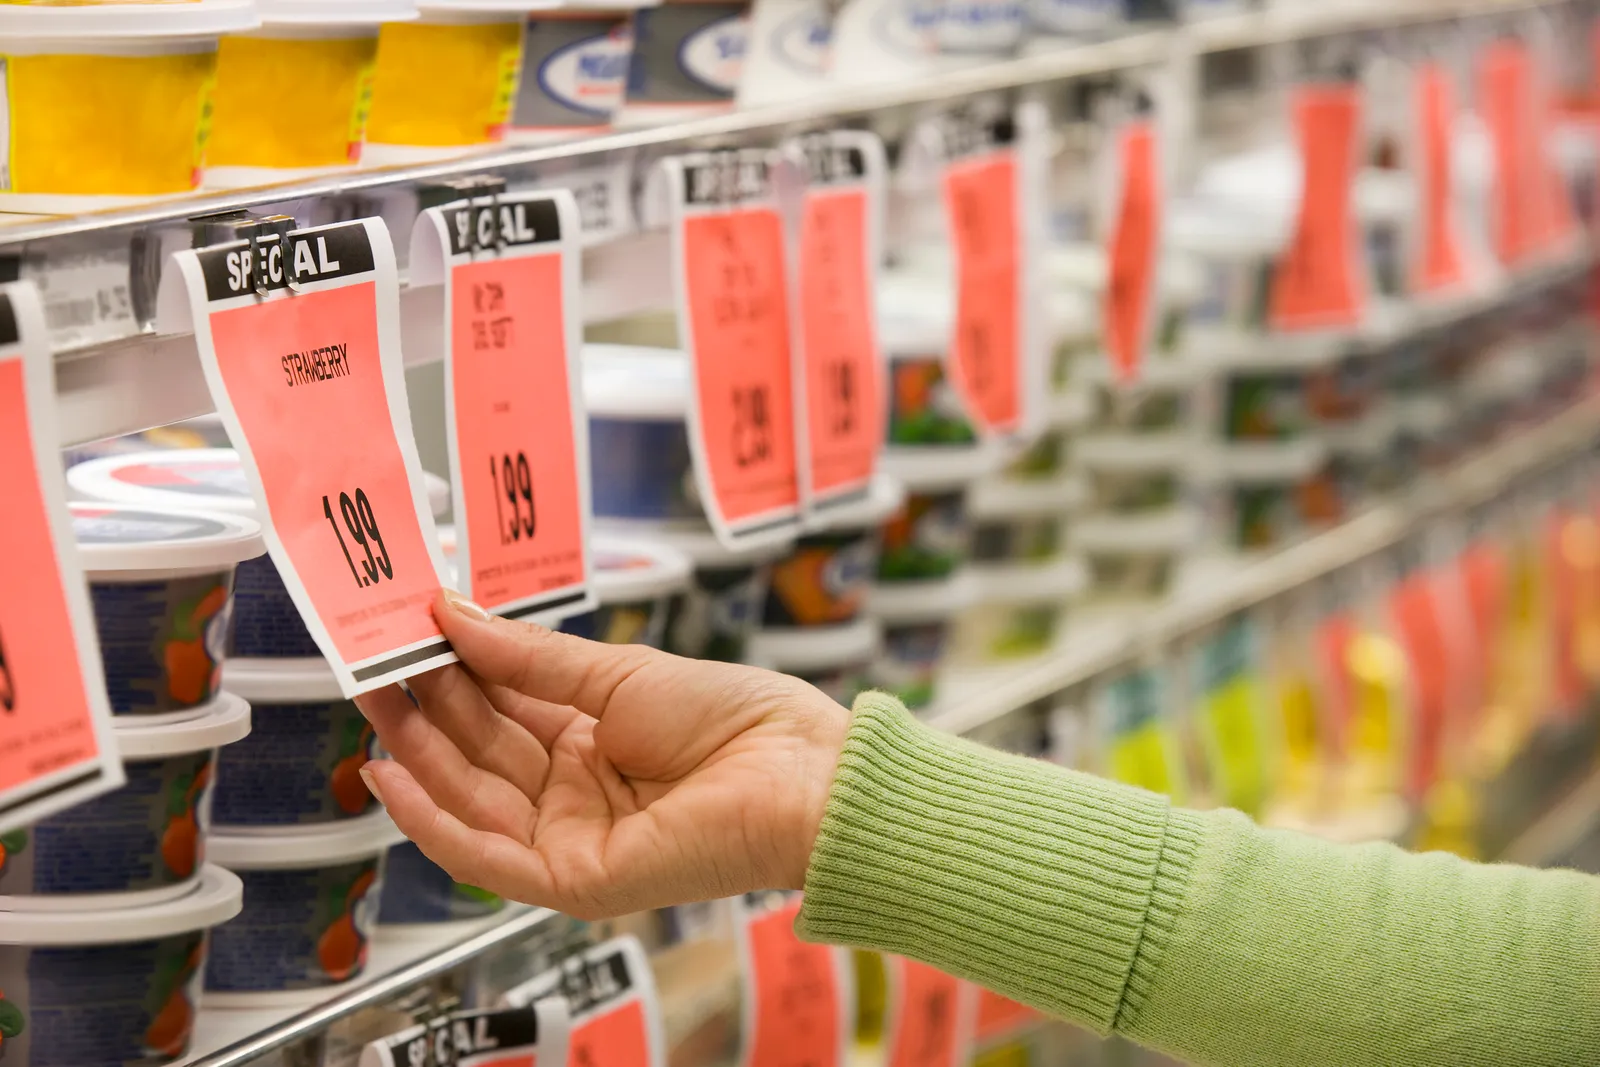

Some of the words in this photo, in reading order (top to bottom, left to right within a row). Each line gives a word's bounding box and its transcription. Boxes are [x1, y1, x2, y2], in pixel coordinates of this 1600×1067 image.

[226, 237, 340, 291] SPECAL
[281, 343, 350, 387] STRAWBERRY
[489, 450, 536, 546] 1.99
[322, 487, 393, 588] 1.99
